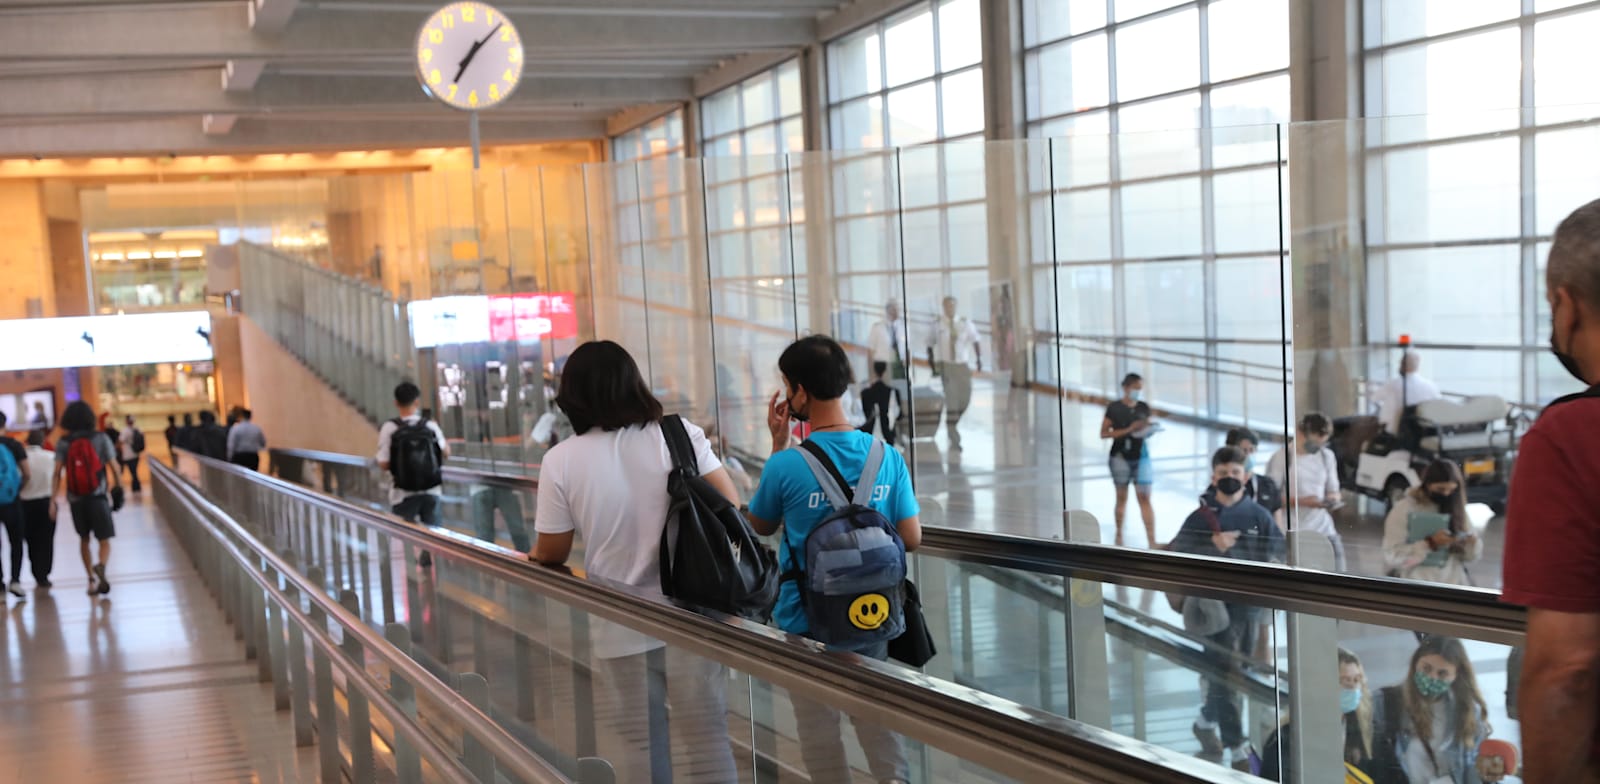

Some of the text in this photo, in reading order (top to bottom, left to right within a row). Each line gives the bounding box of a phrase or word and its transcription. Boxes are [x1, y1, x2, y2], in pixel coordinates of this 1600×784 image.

[441, 12, 455, 29] 11
[461, 6, 475, 23] 12
[428, 27, 444, 45] 10
[500, 26, 513, 42] 2
[508, 47, 519, 63] 3
[448, 84, 458, 101] 7
[488, 83, 500, 101] 5
